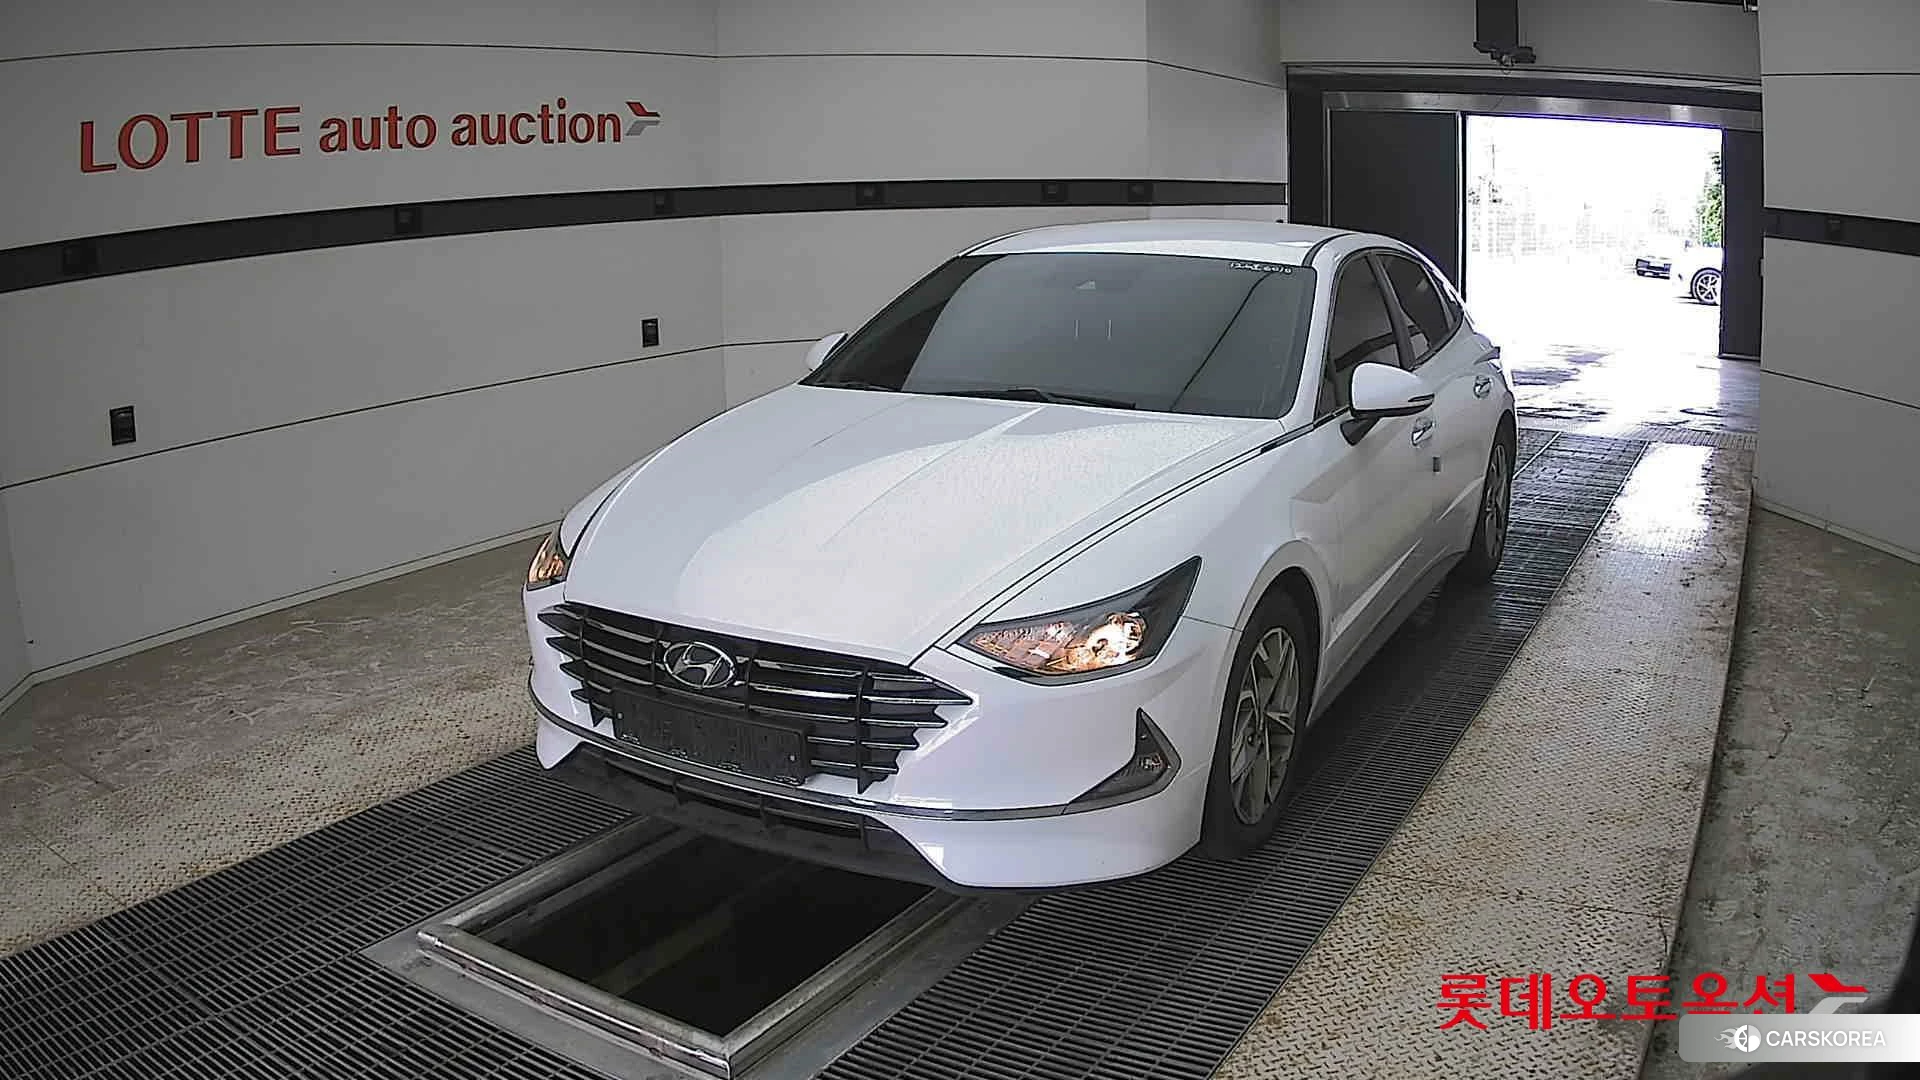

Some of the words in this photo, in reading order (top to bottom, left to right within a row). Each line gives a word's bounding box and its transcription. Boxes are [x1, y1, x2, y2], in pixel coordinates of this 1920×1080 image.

[80, 106, 300, 173] LOTTE
[319, 105, 437, 153] auto
[451, 98, 622, 147] auction
